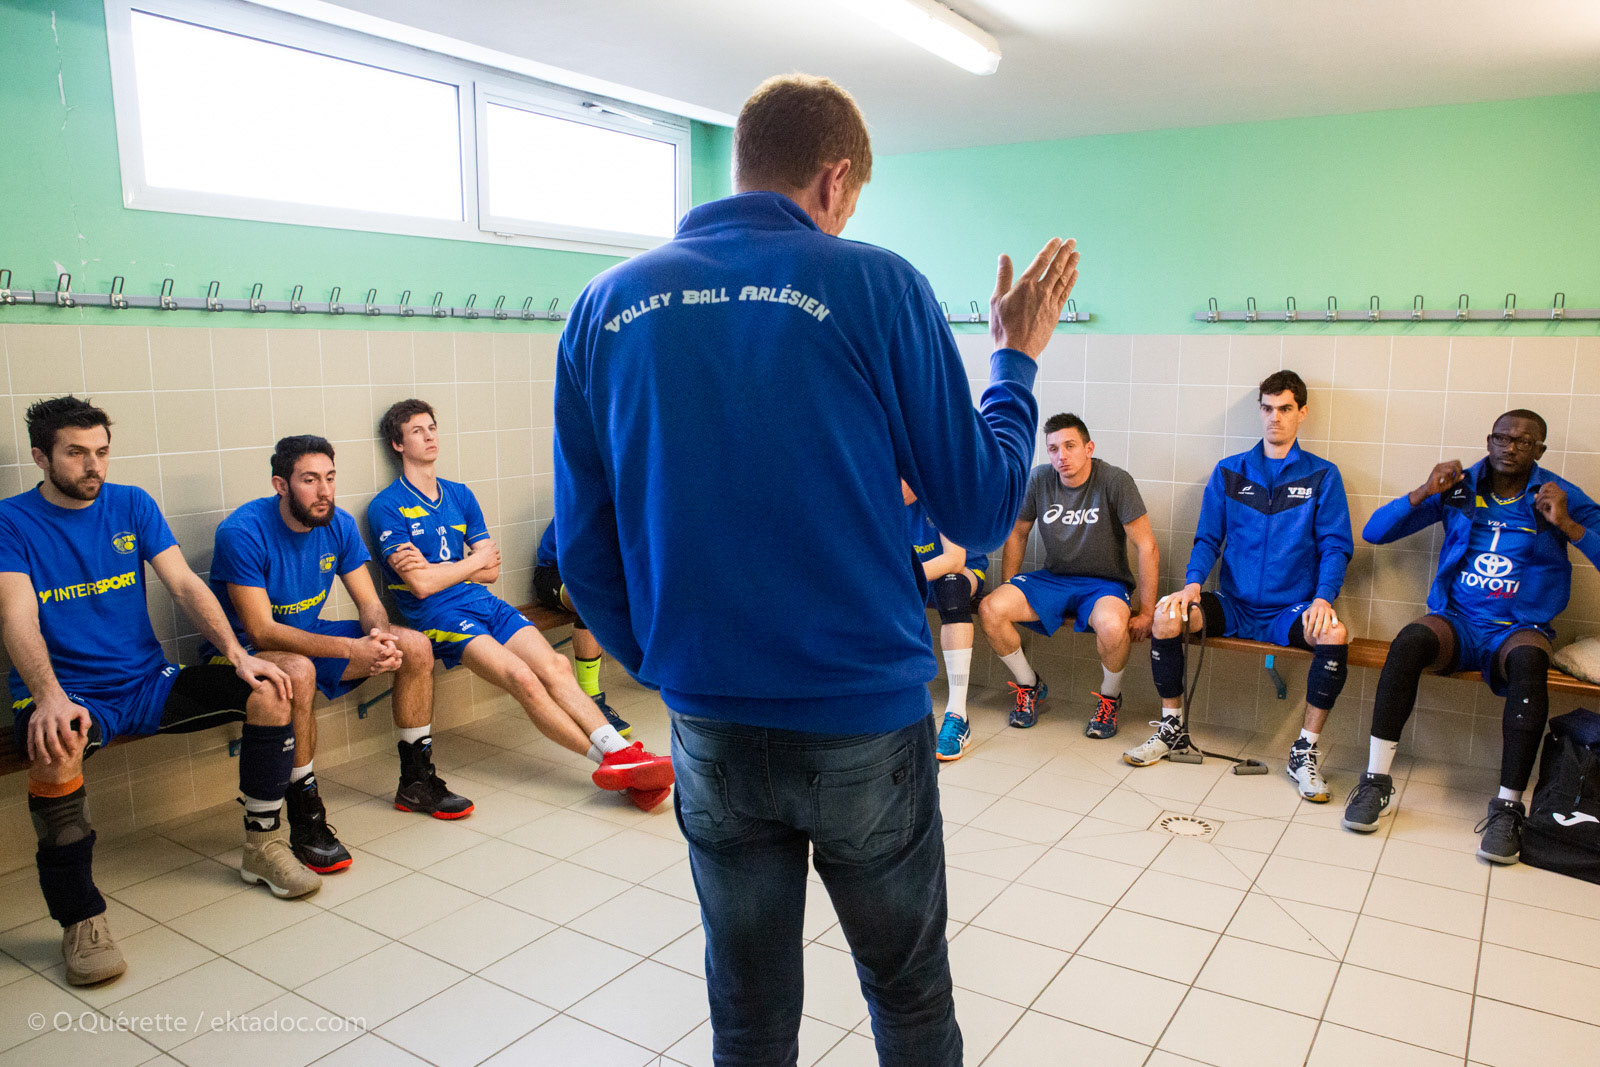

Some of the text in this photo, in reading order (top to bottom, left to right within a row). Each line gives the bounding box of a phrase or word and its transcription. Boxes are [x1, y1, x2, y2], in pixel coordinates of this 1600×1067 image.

[604, 284, 830, 333] VOLLEY BALL ARLÉSIEN
[439, 535, 451, 561] 8
[1489, 526, 1501, 552] 1
[53, 571, 136, 602] INTERSPORT
